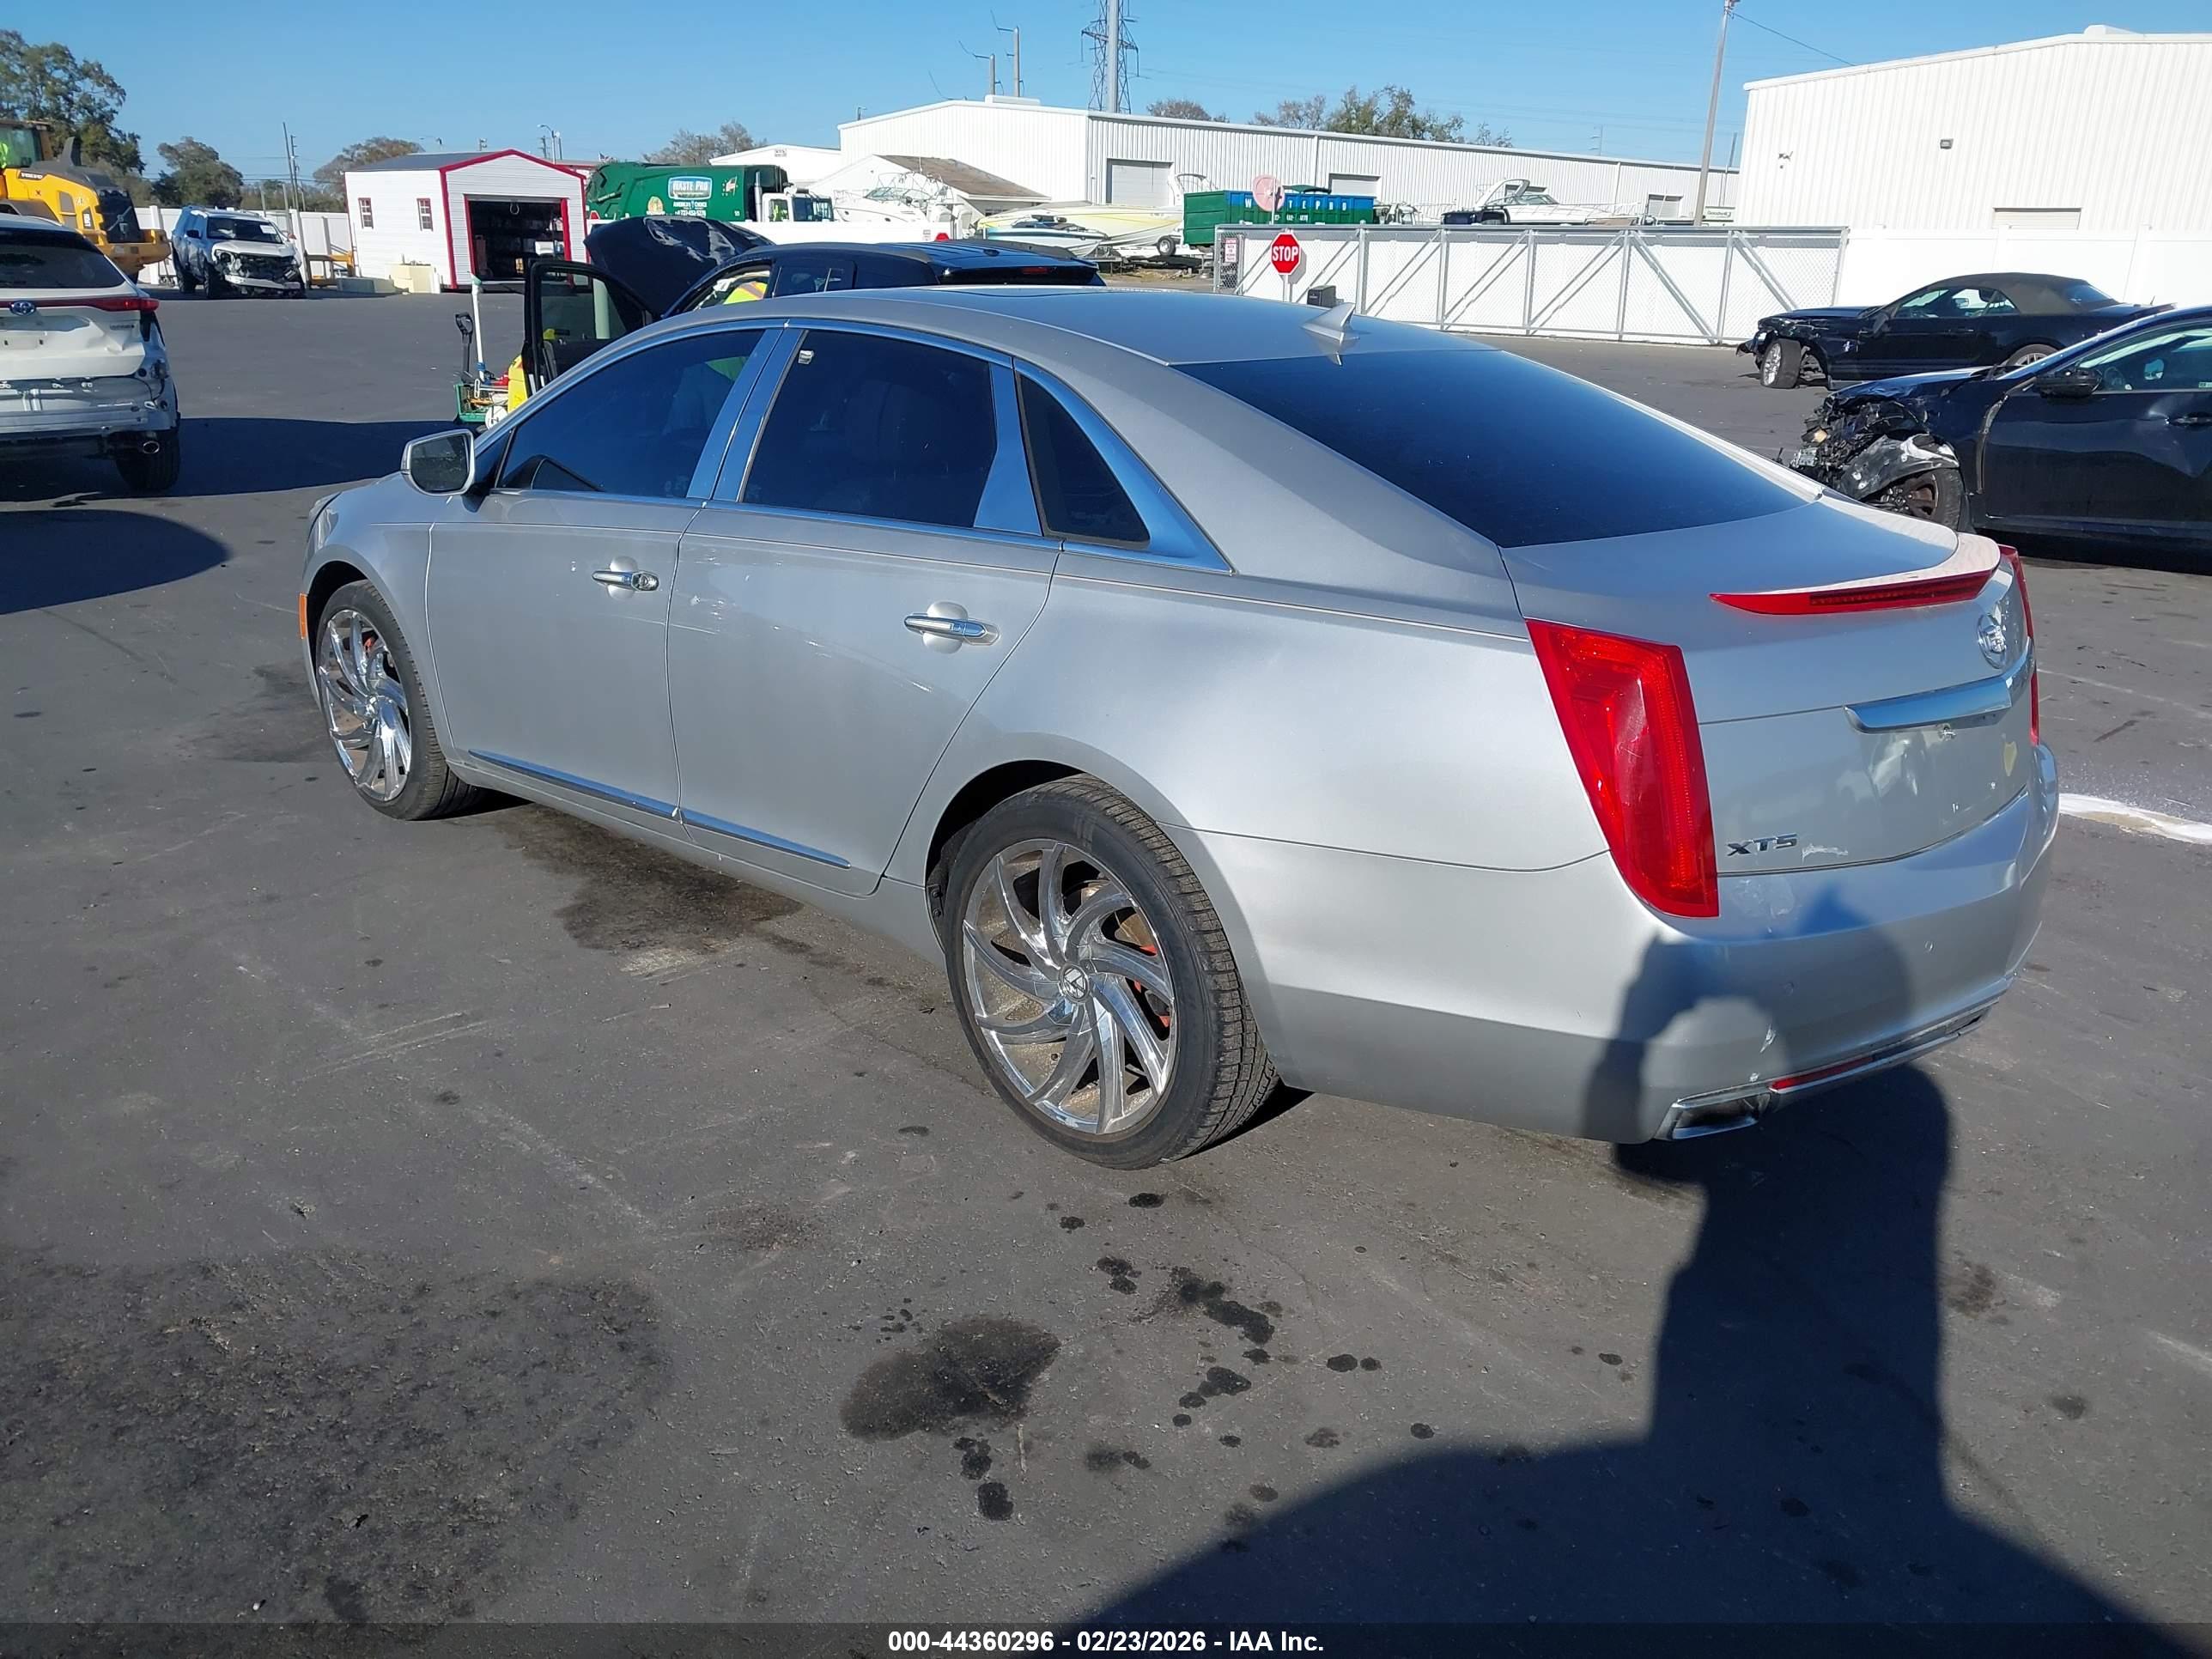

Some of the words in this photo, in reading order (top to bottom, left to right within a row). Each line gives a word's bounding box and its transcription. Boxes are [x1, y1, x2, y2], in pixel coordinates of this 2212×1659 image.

[672, 180, 692, 191] WASTE
[696, 180, 708, 191] PRO
[1272, 246, 1299, 262] STOP
